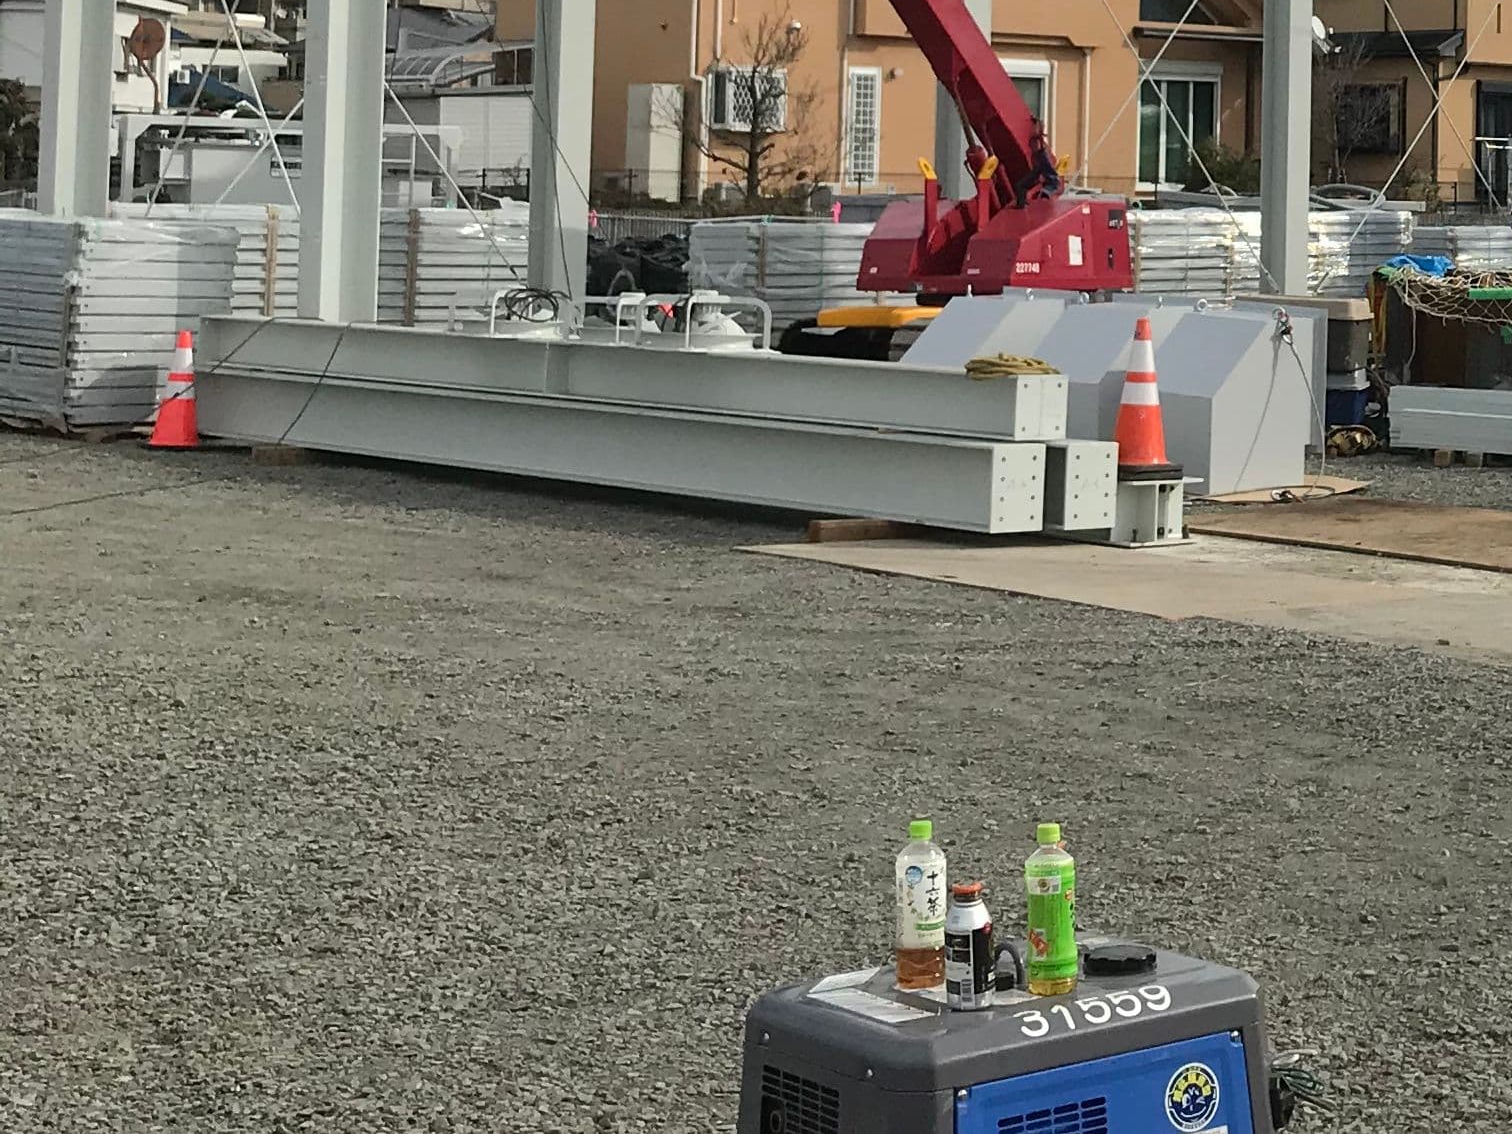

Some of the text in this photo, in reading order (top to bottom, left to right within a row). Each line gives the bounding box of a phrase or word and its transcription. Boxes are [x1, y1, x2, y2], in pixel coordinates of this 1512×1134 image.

[925, 870, 942, 916] 十六茶
[1013, 984, 1172, 1038] 31559
